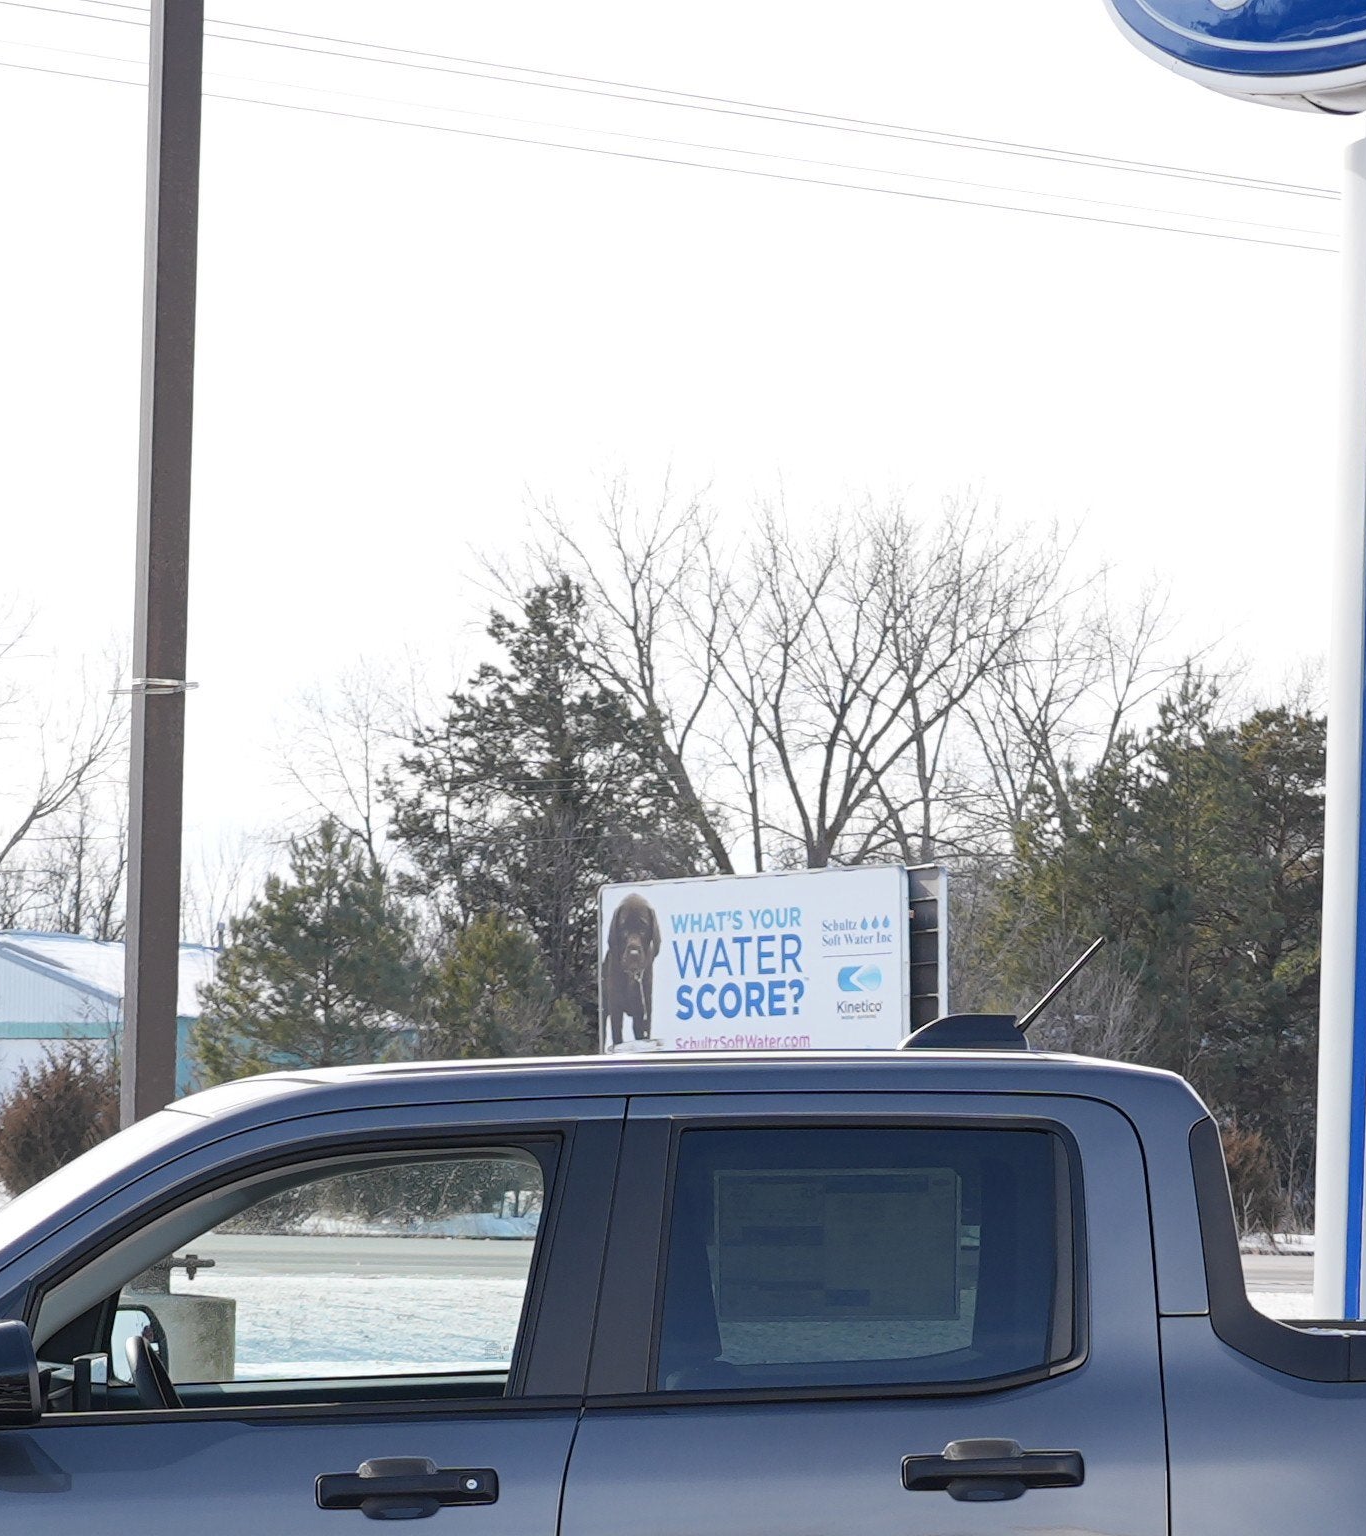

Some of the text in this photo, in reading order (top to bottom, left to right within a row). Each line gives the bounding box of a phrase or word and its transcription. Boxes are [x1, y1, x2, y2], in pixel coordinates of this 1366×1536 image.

[671, 906, 801, 934] WHAT'S YOUR
[822, 918, 857, 932] Schultz
[822, 931, 893, 947] Soft Water Inc
[672, 933, 803, 979] WATER
[676, 979, 805, 1020] SCORE?
[836, 1000, 882, 1014] Kinetico
[675, 1034, 810, 1050] SchultzSoftWater.com
